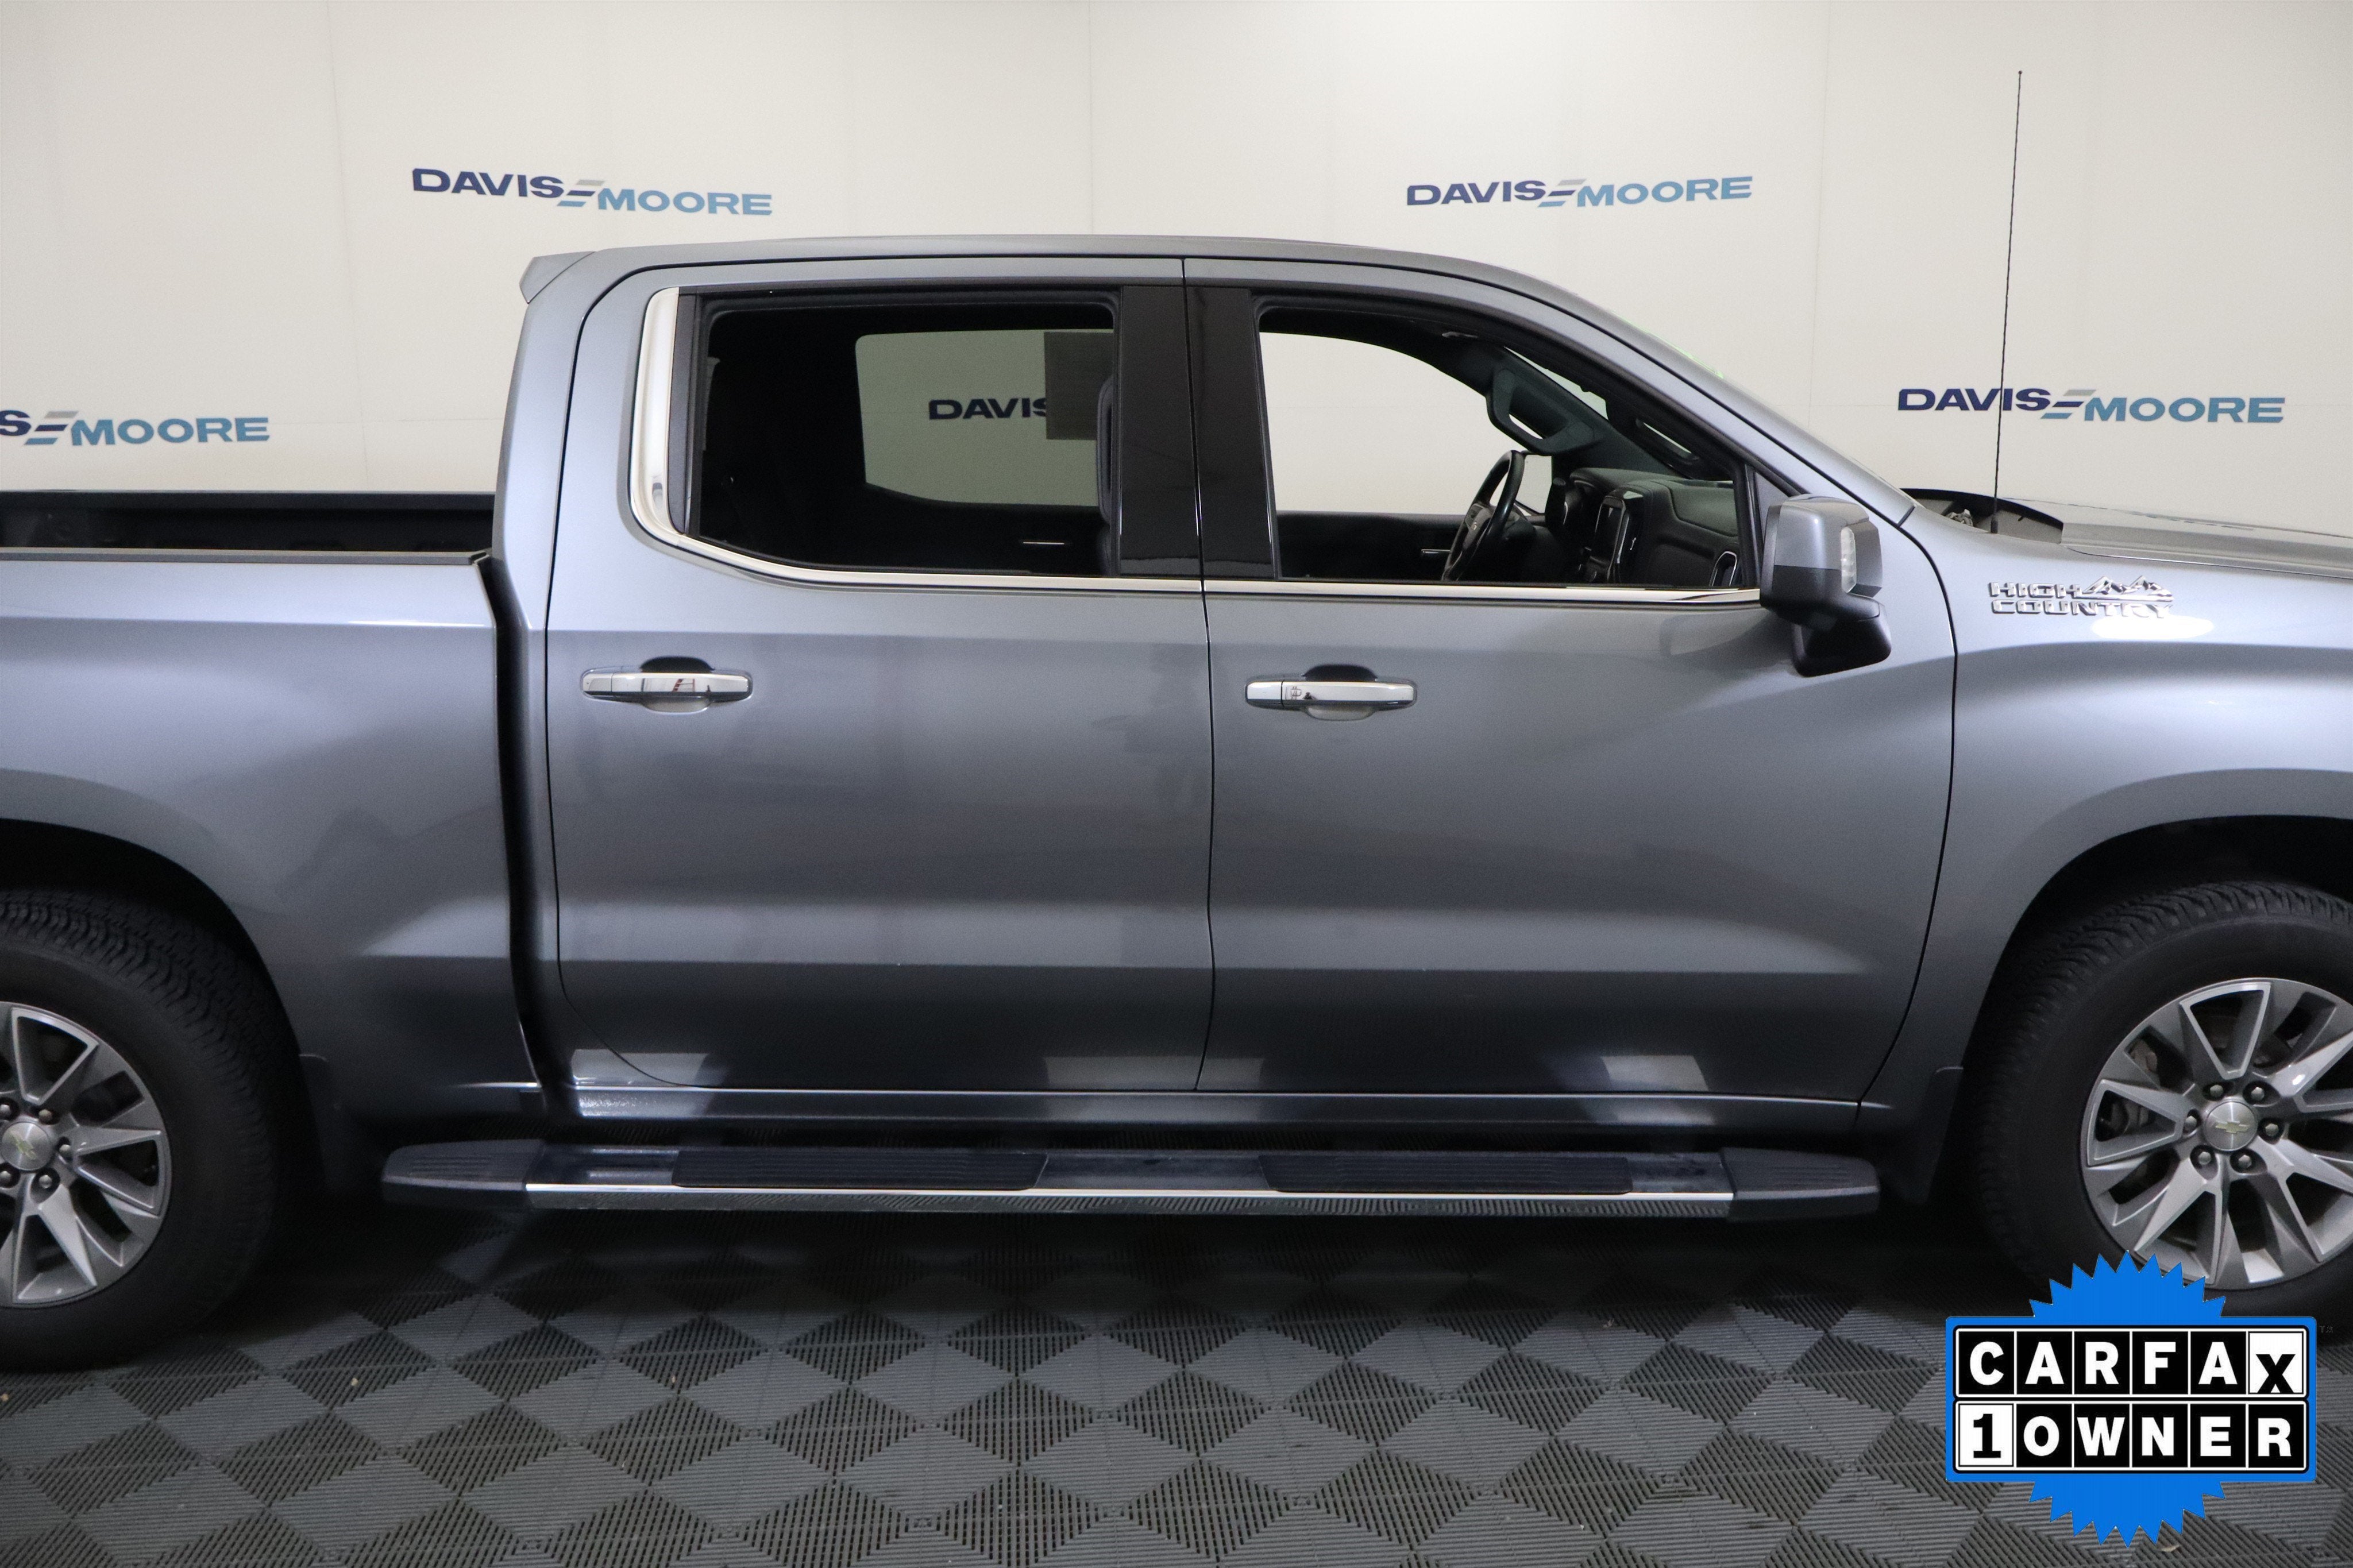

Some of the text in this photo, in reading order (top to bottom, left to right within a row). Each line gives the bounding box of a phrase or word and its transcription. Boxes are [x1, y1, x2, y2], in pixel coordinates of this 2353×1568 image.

[412, 168, 772, 215] DAVIS MOORE
[1406, 176, 1753, 207] DAVIS MOORE
[1898, 388, 2285, 423] DAVIS MOORE
[71, 417, 270, 446] MOORE
[1989, 581, 2083, 598] HIGH
[1991, 600, 2173, 619] COUNTRY
